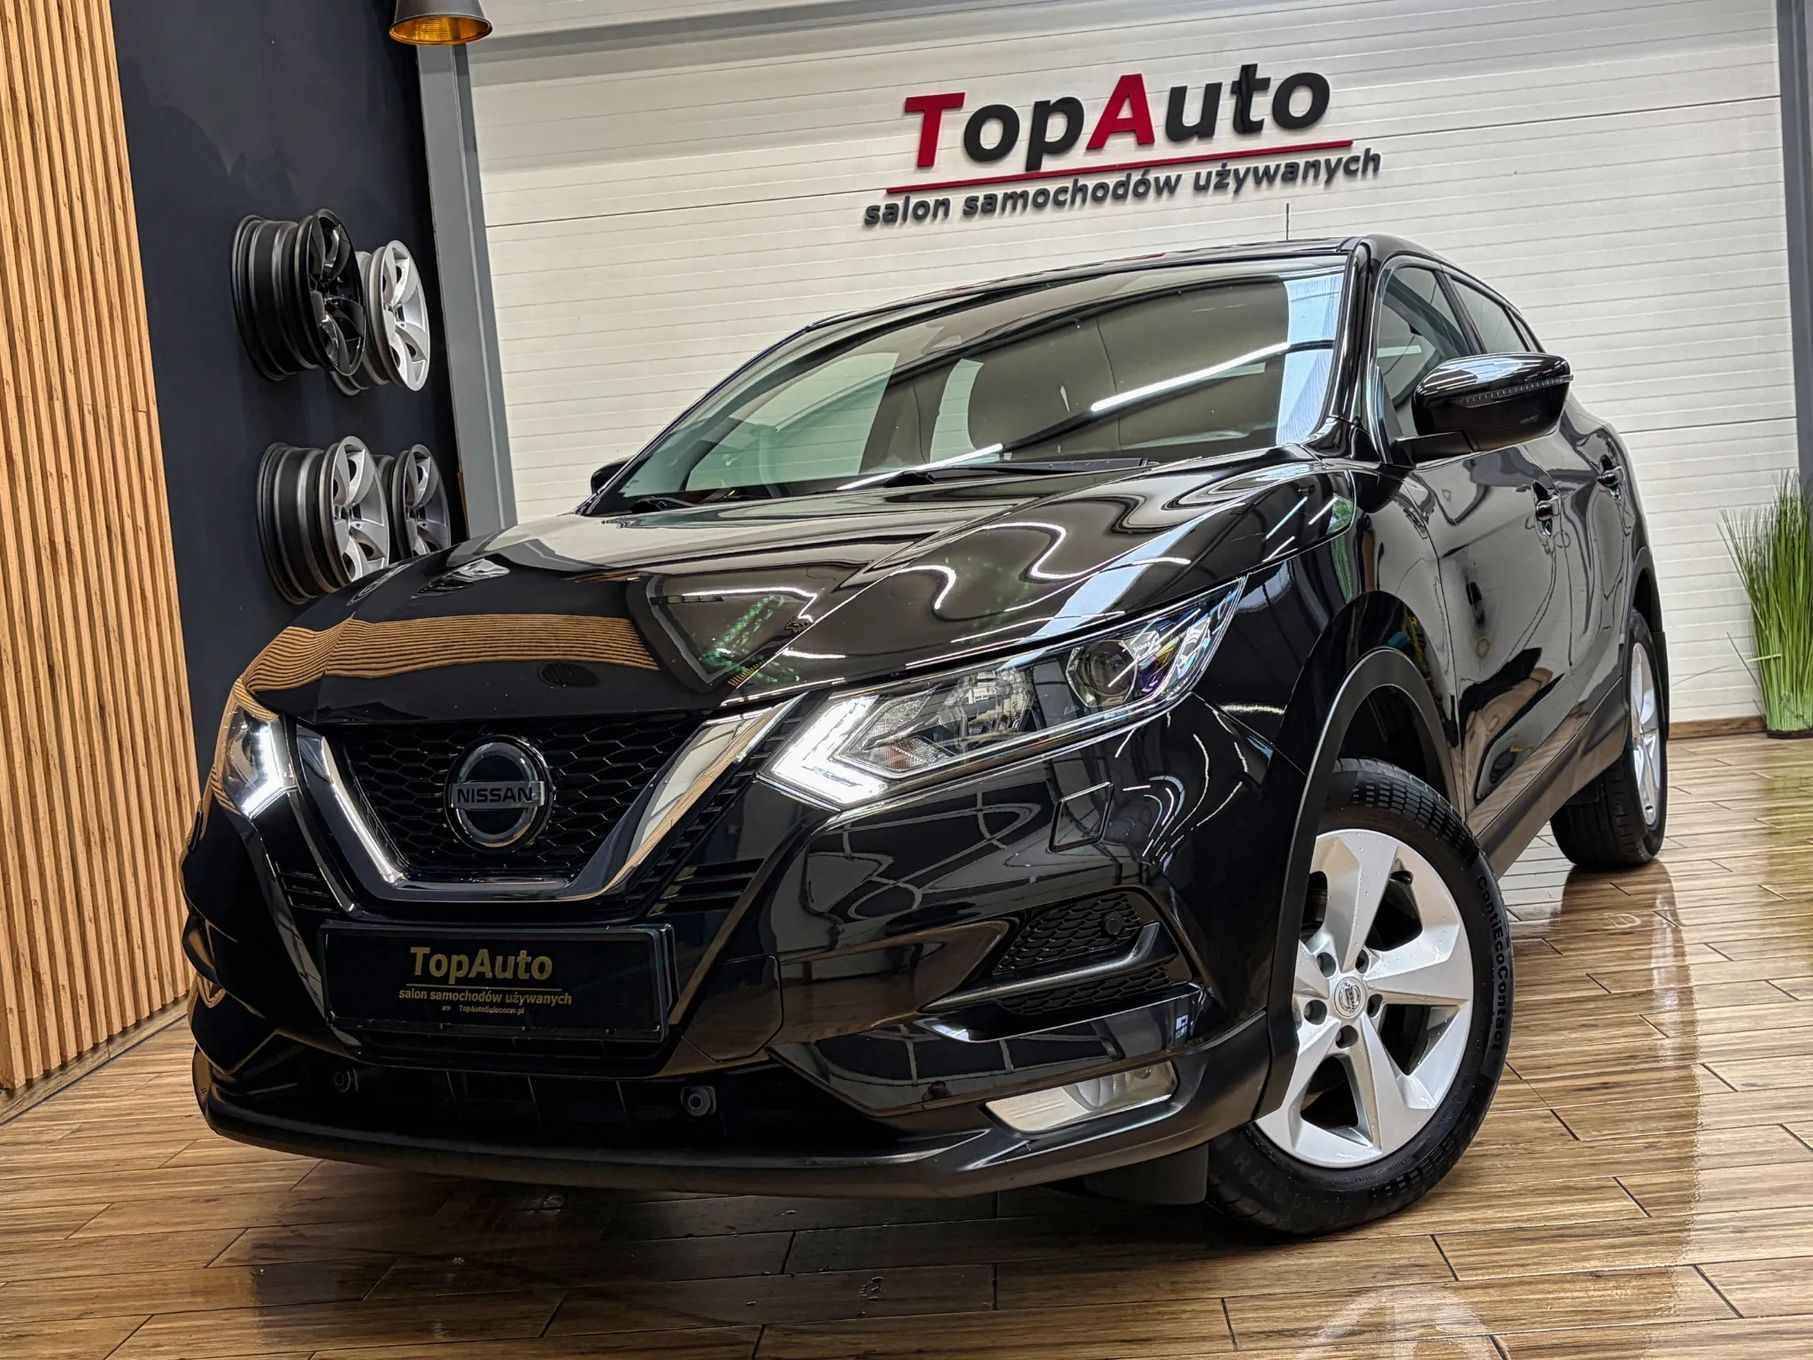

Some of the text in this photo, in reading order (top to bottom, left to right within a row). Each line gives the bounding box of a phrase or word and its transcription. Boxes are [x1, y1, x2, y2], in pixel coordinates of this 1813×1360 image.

[904, 63, 1331, 172] TopAuto
[864, 147, 1382, 226] salon samochodów używanych
[456, 786, 533, 804] NISSAN
[410, 946, 553, 985] TopAuto
[1476, 874, 1509, 1050] ContiEcoContact
[399, 988, 573, 1007] salon samochodów używanych
